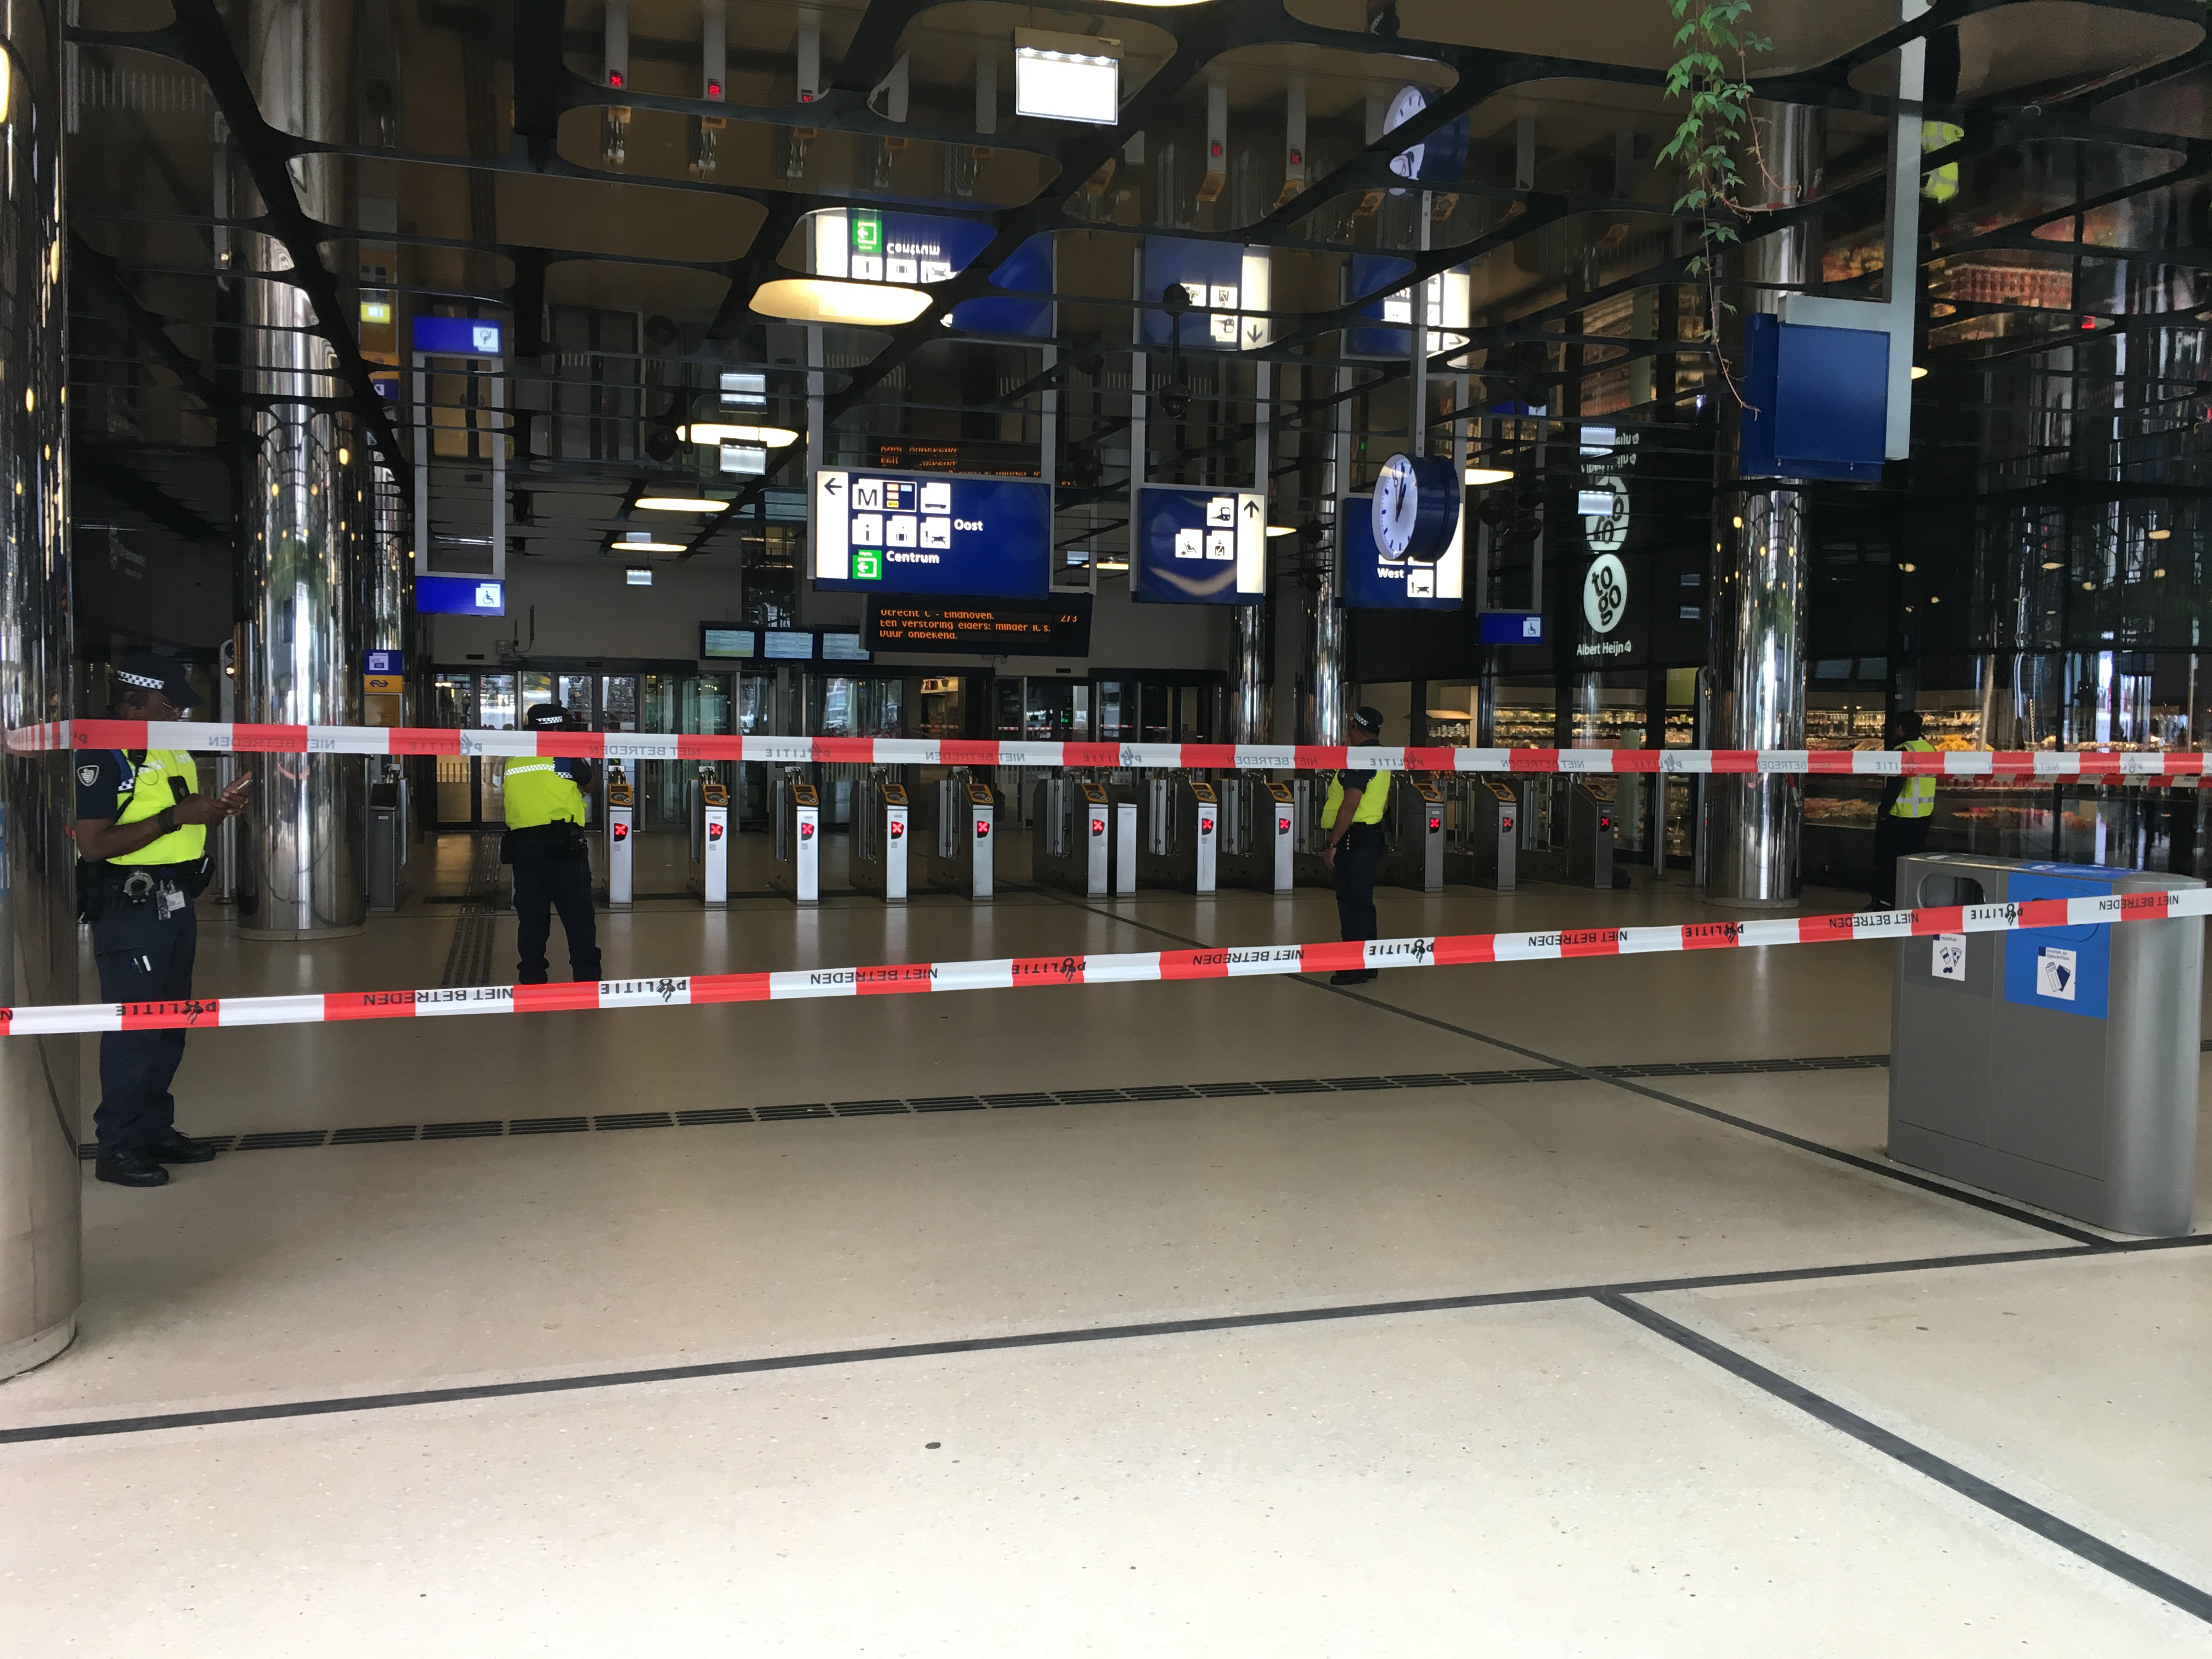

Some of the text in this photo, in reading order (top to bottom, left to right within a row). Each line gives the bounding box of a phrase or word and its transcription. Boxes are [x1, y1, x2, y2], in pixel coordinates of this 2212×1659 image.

[859, 488, 877, 506] M
[954, 519, 983, 531] Oost
[886, 551, 940, 563] Centrum
[1377, 568, 1404, 578] West
[1592, 566, 1612, 596] to
[1598, 585, 1621, 626] go
[1576, 641, 1623, 656] Albert Heijn
[2099, 895, 2179, 911] NIET BETREDEN
[1829, 912, 1918, 928] NIET BETREDEN
[1528, 931, 1628, 947] NIET BETREDEN
[1193, 949, 1304, 965] NIET BETREDEN
[810, 968, 938, 985] NIET BETREDEN
[364, 988, 514, 1006] NIET BETREDEN
